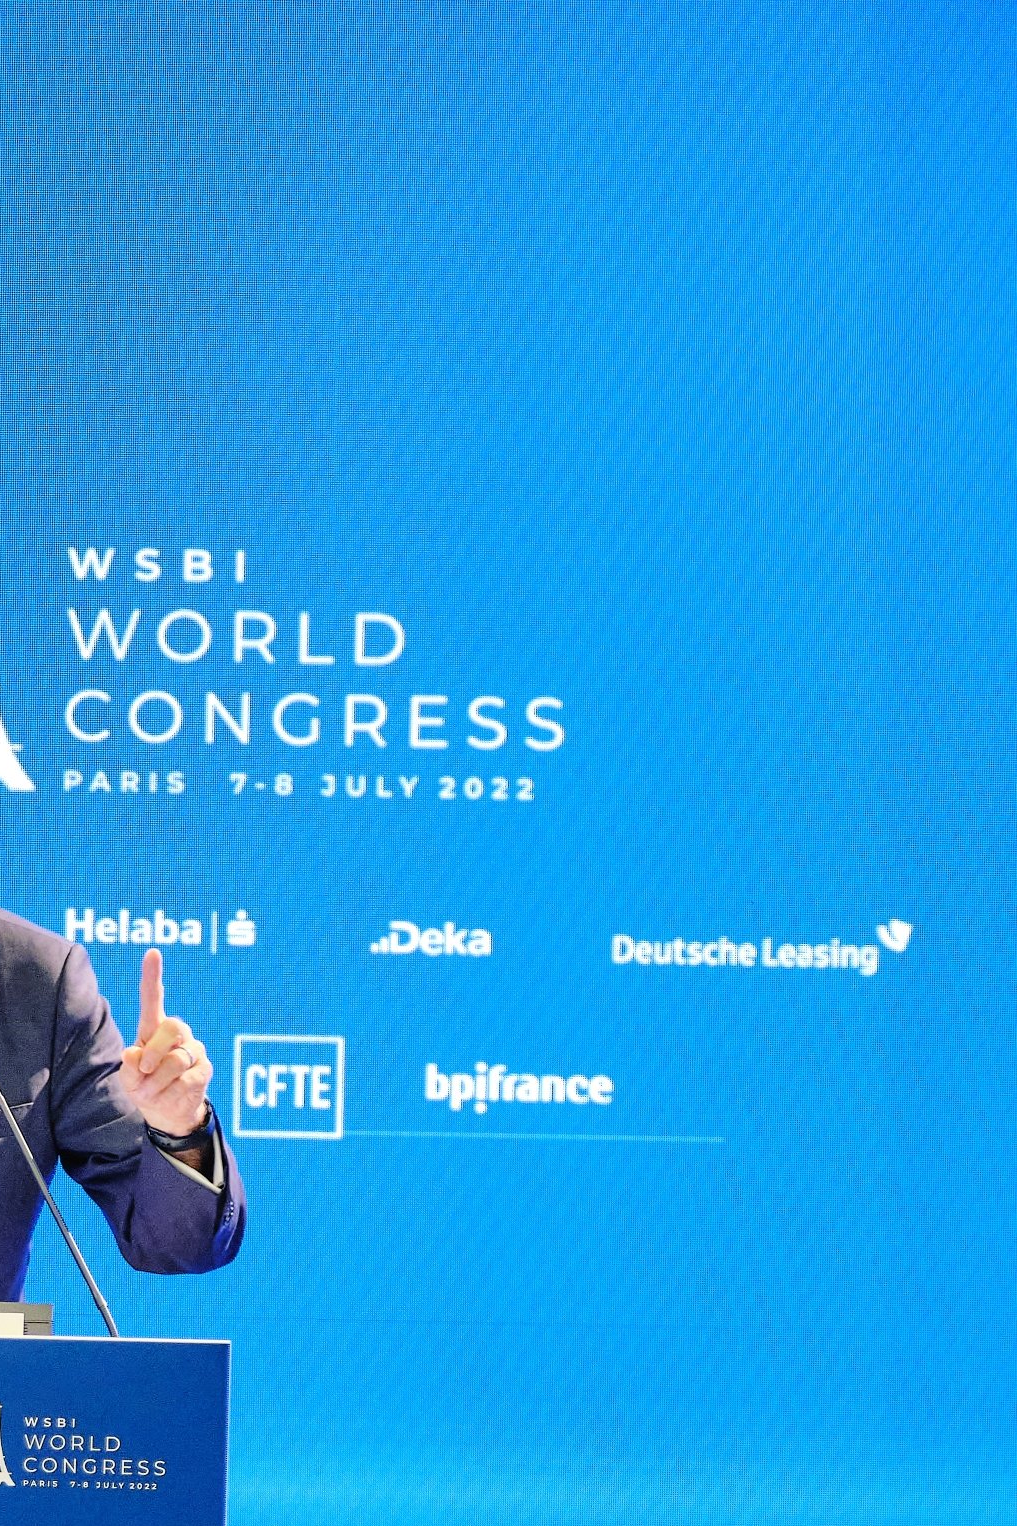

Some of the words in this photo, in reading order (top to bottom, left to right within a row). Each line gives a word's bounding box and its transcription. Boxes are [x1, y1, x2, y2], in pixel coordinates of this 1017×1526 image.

[68, 546, 246, 583] WSBI
[69, 607, 405, 666] WORLD
[64, 690, 565, 751] CONGRESS
[63, 769, 186, 794] PARIS
[229, 771, 295, 796] 7-8
[320, 773, 420, 799] JULY
[438, 776, 537, 801] 2022
[65, 909, 203, 946] Helaba
[612, 934, 756, 968] Deutsche
[761, 938, 880, 976] Leasing
[244, 1062, 331, 1110] CFTE
[425, 1062, 614, 1114] bpifrance
[24, 1417, 76, 1428] WSBI
[24, 1434, 121, 1451] WORLD
[23, 1458, 166, 1476] CONGRESS
[23, 1480, 58, 1488] PARIS
